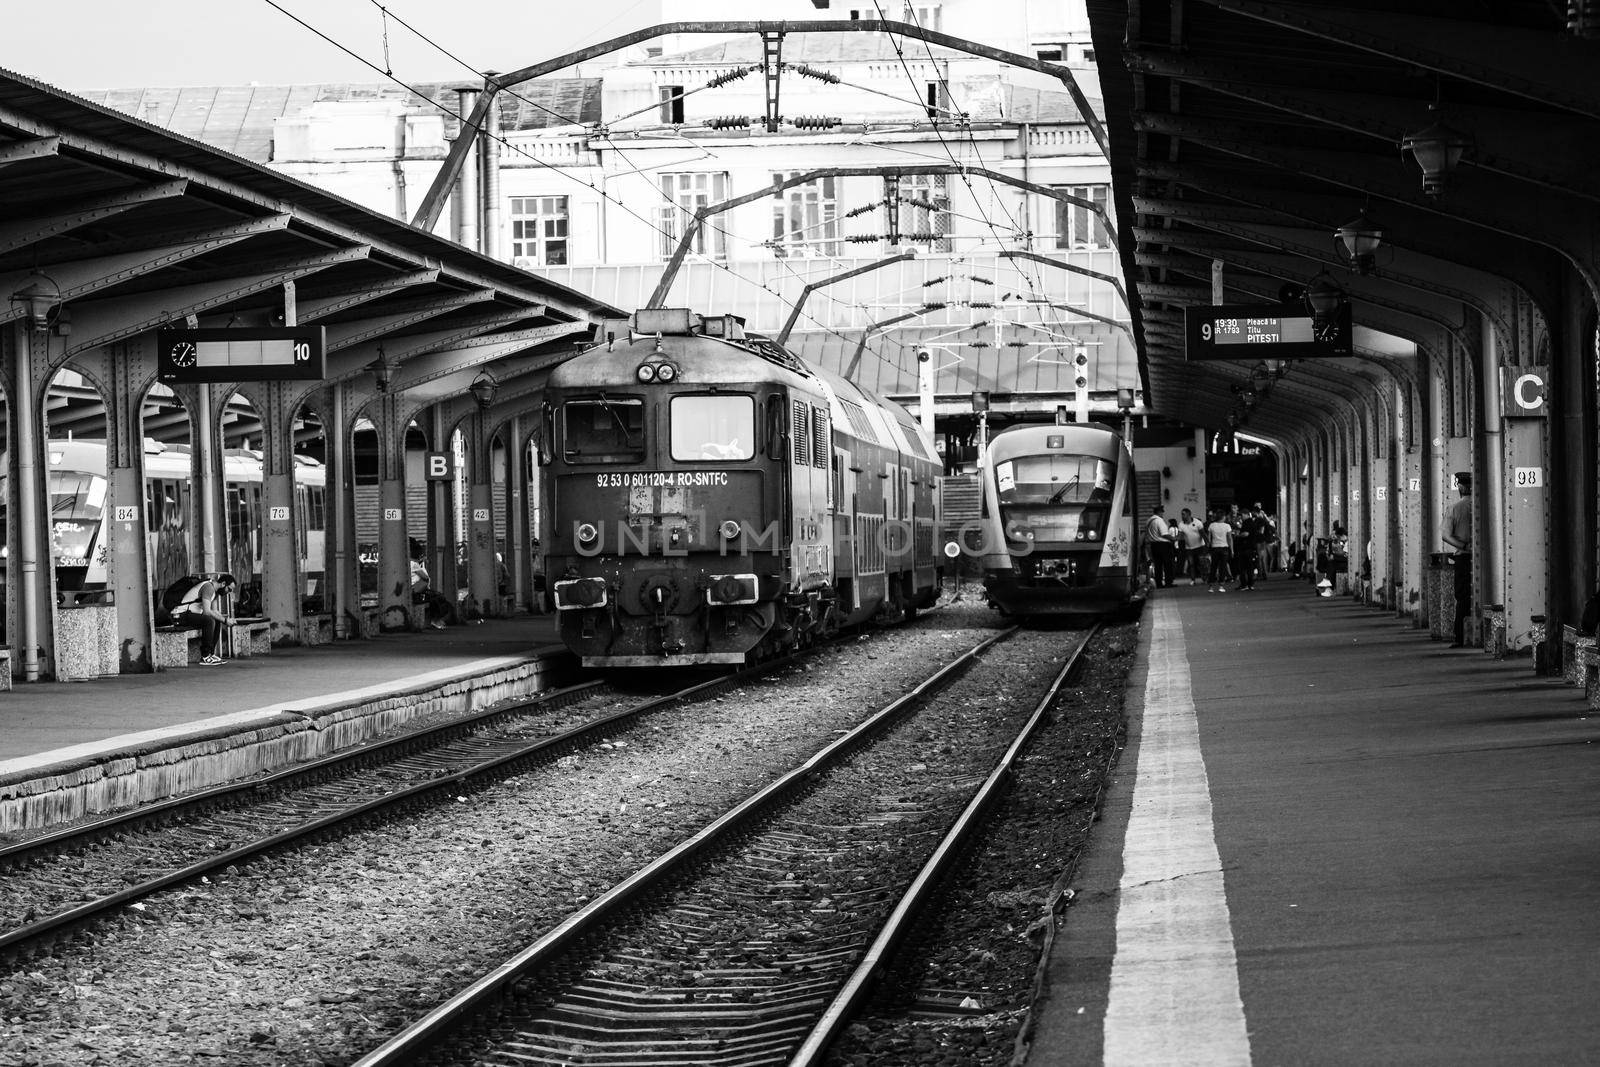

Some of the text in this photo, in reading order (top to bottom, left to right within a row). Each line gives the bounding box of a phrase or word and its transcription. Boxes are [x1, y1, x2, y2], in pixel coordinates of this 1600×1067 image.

[1215, 318, 1238, 328] 19:30
[1201, 323, 1212, 341] 9
[1247, 326, 1261, 334] Titu
[294, 343, 310, 361] 10
[1513, 373, 1544, 410] C
[430, 455, 448, 477] B
[597, 472, 728, 487] 92 53 0 601120-4 RO-SNTFC
[1517, 471, 1537, 485] 98
[118, 508, 133, 520] 84
[271, 508, 285, 519] 70
[386, 510, 397, 519] 56
[475, 510, 486, 519] 42
